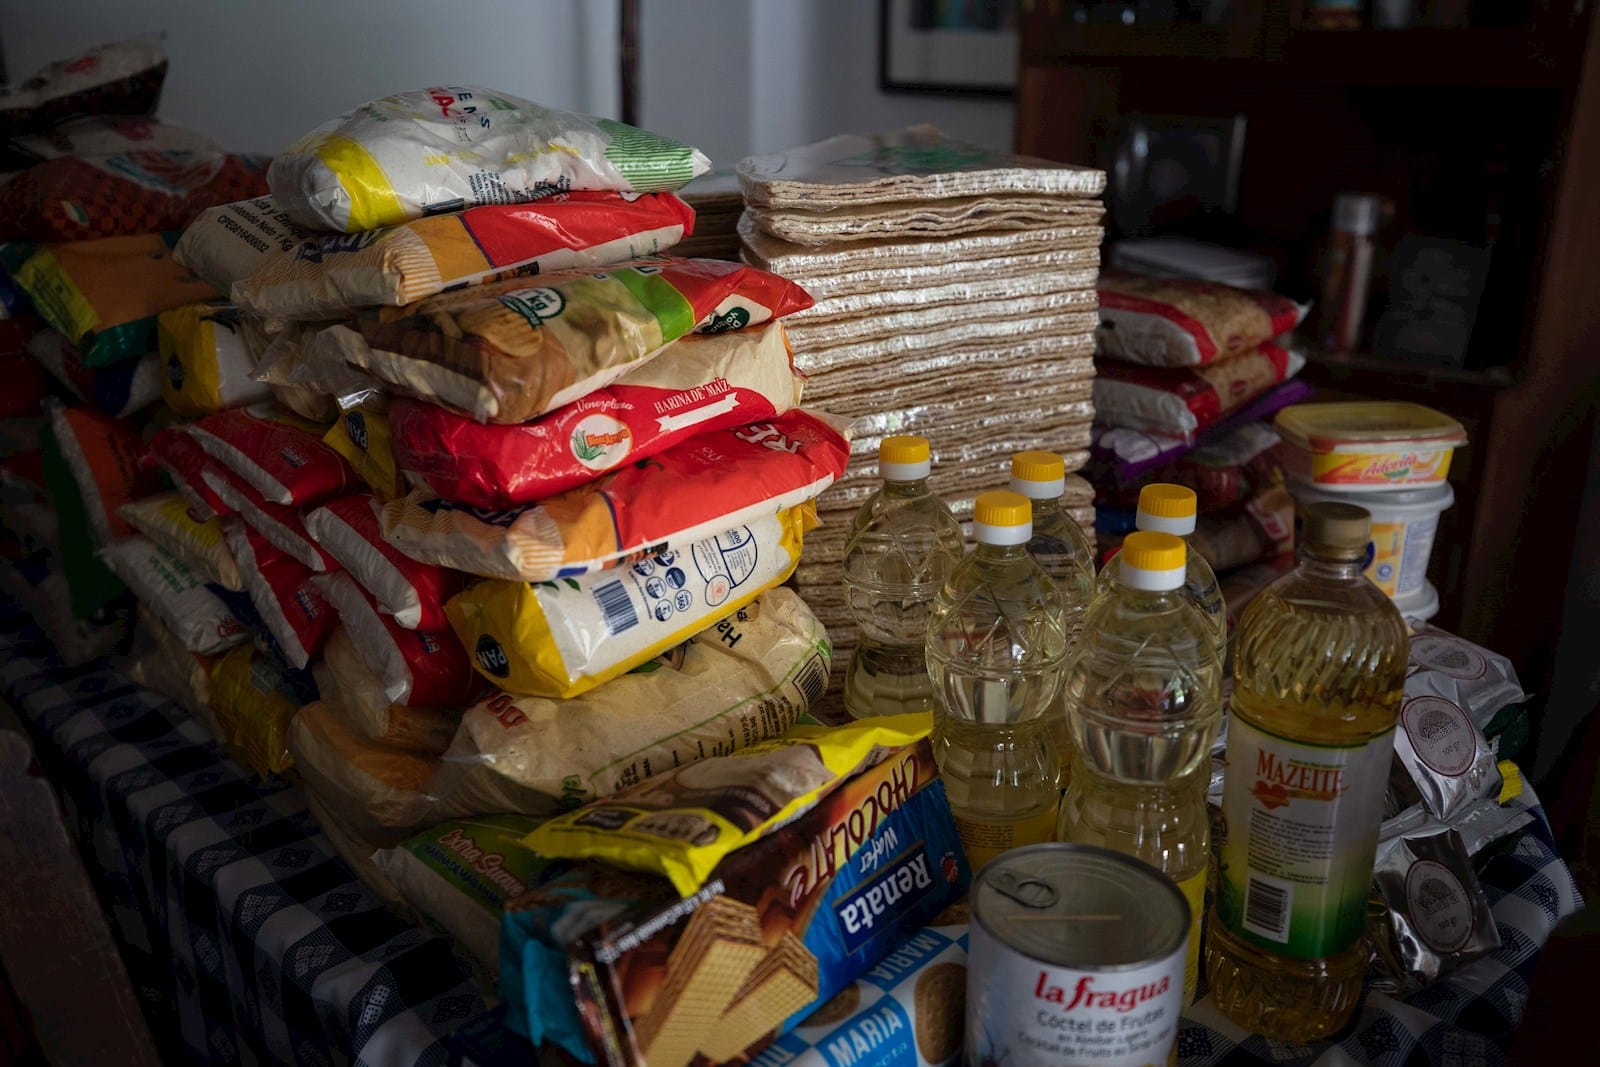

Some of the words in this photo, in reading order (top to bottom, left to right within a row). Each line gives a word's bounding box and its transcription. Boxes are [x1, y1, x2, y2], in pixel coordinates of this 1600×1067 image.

[256, 220, 277, 238] Neto
[654, 391, 692, 415] HARINA
[690, 385, 706, 402] DE
[479, 640, 507, 678] PAN
[1256, 748, 1344, 794] MAZEITE
[858, 825, 900, 874] Wafer
[838, 850, 934, 936] Renata
[870, 932, 942, 984] MARIA
[827, 1004, 904, 1067] MARIA
[1036, 1009, 1092, 1034] Cóctel
[1095, 1018, 1117, 1034] de
[1120, 1007, 1166, 1031] Frutas
